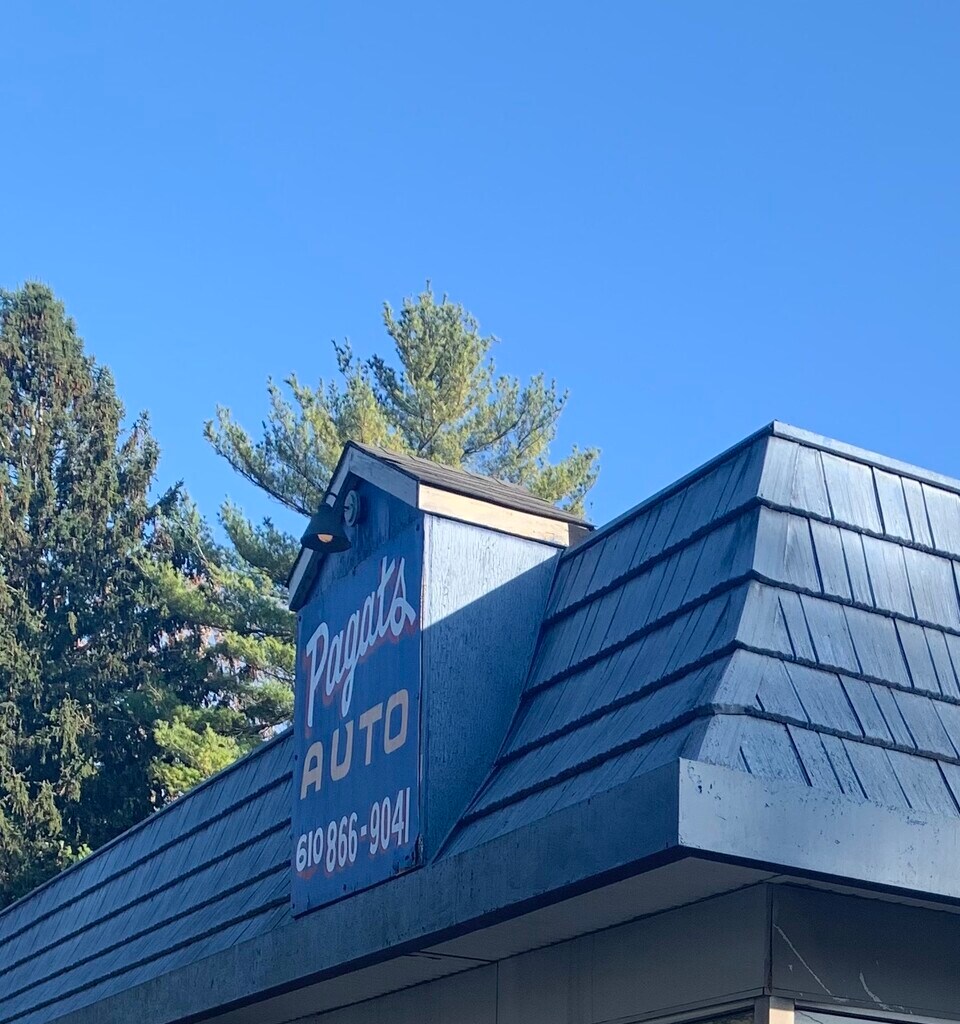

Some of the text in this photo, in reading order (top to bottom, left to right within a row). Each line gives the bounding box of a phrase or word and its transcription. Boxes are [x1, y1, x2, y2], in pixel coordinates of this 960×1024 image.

[300, 688, 409, 800] AUTO
[296, 787, 411, 873] 610 866-9041
